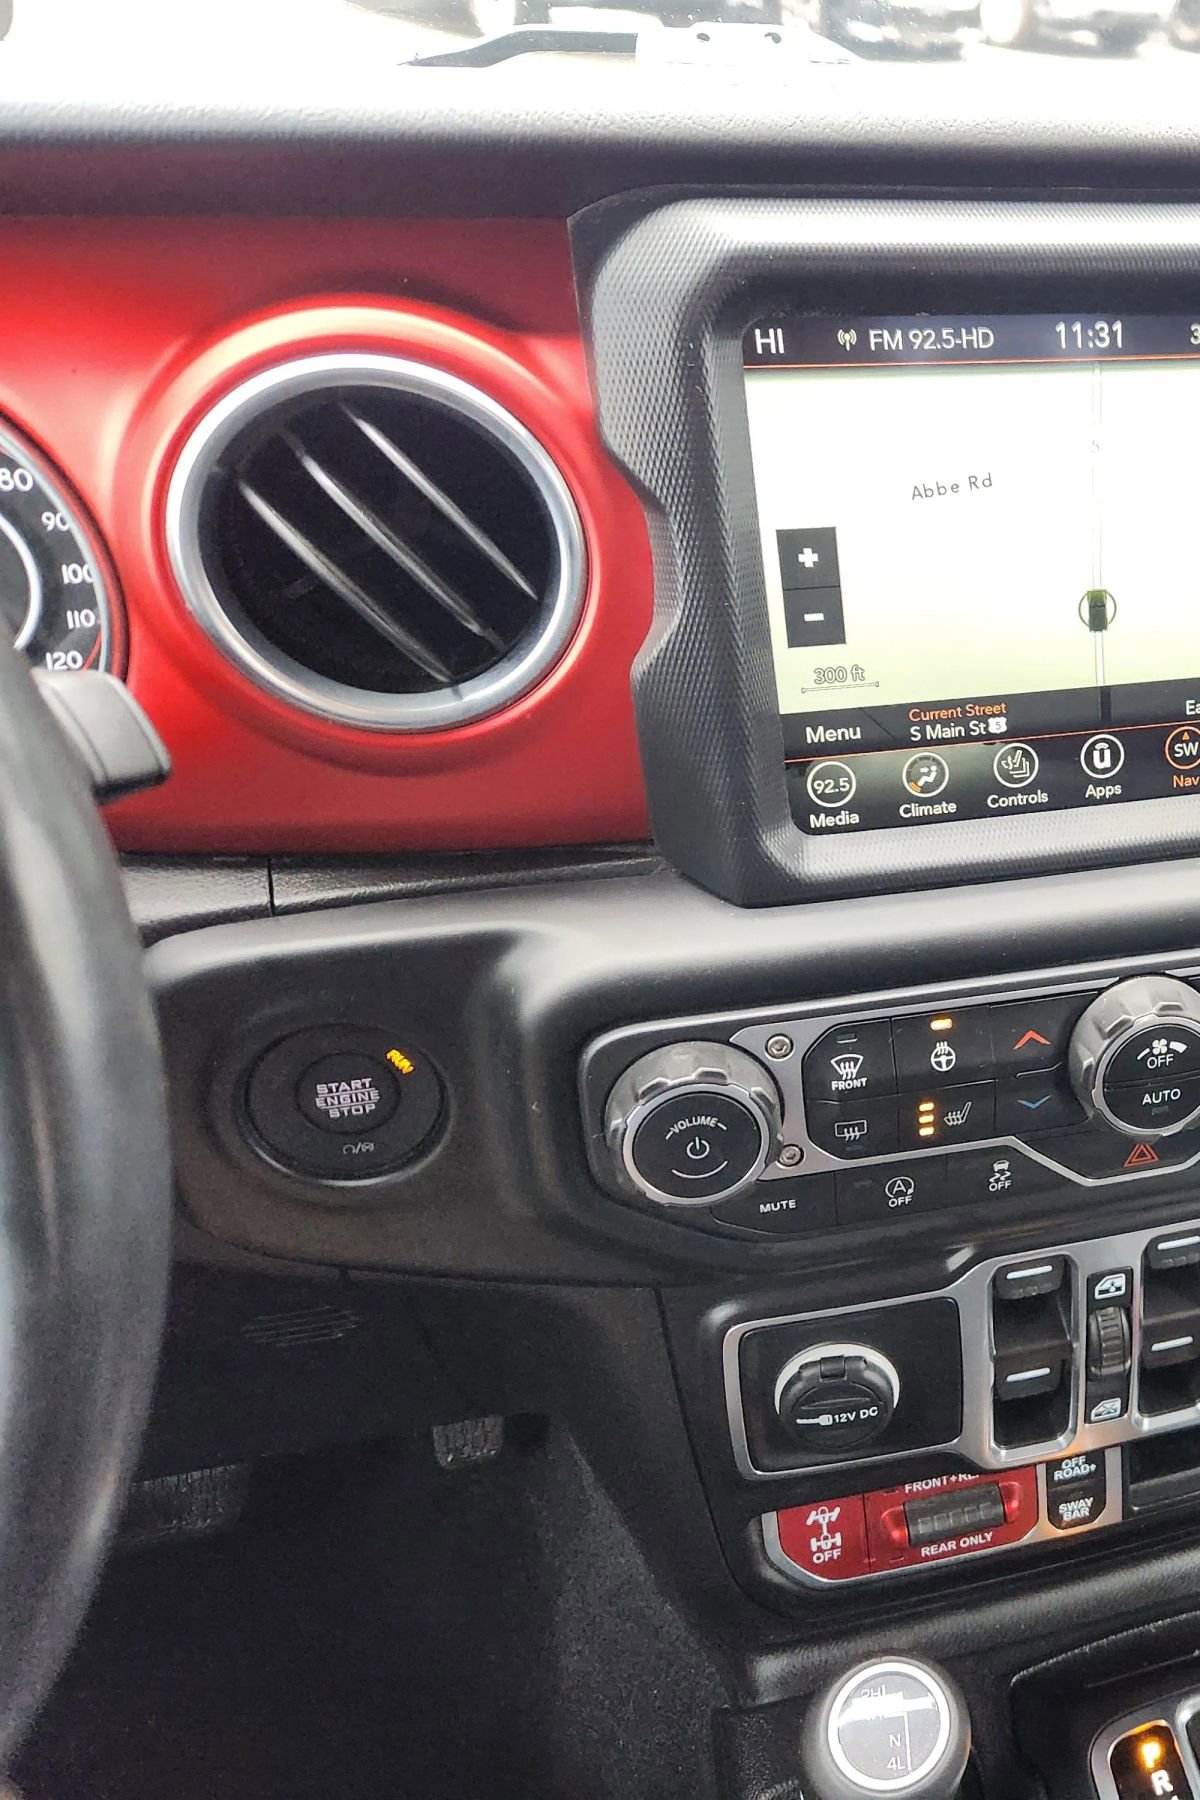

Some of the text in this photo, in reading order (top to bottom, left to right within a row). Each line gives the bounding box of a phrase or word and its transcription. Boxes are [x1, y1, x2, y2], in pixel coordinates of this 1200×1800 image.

[755, 328, 785, 354] HI
[869, 328, 995, 351] FM 92.5-HD
[1055, 320, 1123, 349] 11:31
[0, 467, 33, 492] 80
[912, 472, 993, 501] Abbe Rd
[41, 511, 70, 532] 90
[61, 564, 94, 585] 100
[66, 609, 96, 630] 110
[46, 651, 83, 671] 120
[813, 664, 865, 684] 300 ft
[908, 702, 1007, 722] Current Street
[805, 725, 861, 744] Menu
[910, 727, 921, 742] S
[926, 722, 965, 740] Main
[969, 721, 986, 737] St
[1174, 741, 1200, 757] SW
[813, 777, 850, 794] 92.5
[1172, 774, 1200, 788] Nav
[987, 789, 1049, 809] Controls
[1085, 783, 1122, 800] Apps
[899, 801, 957, 818] Climate
[809, 811, 860, 829] Media
[1147, 1054, 1174, 1069] OFF
[316, 1078, 372, 1094] START
[831, 1077, 868, 1091] FRONT
[315, 1089, 380, 1108] ENGINE
[1142, 1088, 1181, 1106] AUTO
[329, 1103, 376, 1119] STOP
[670, 1115, 718, 1135] VOLUME
[988, 1180, 1012, 1192] OFF
[759, 1199, 797, 1213] MUTE
[888, 1195, 912, 1208] OFF
[833, 1407, 879, 1424] 12V DC
[1061, 1456, 1086, 1470] OFF
[1059, 1497, 1094, 1514] SWAY
[1063, 1507, 1090, 1521] BAR
[921, 1531, 994, 1557] REAR ONLY
[813, 1548, 841, 1565] OFF
[889, 1733, 901, 1748] N
[887, 1755, 906, 1771] 4L
[1141, 1741, 1160, 1769] P
[1151, 1769, 1174, 1796] R
